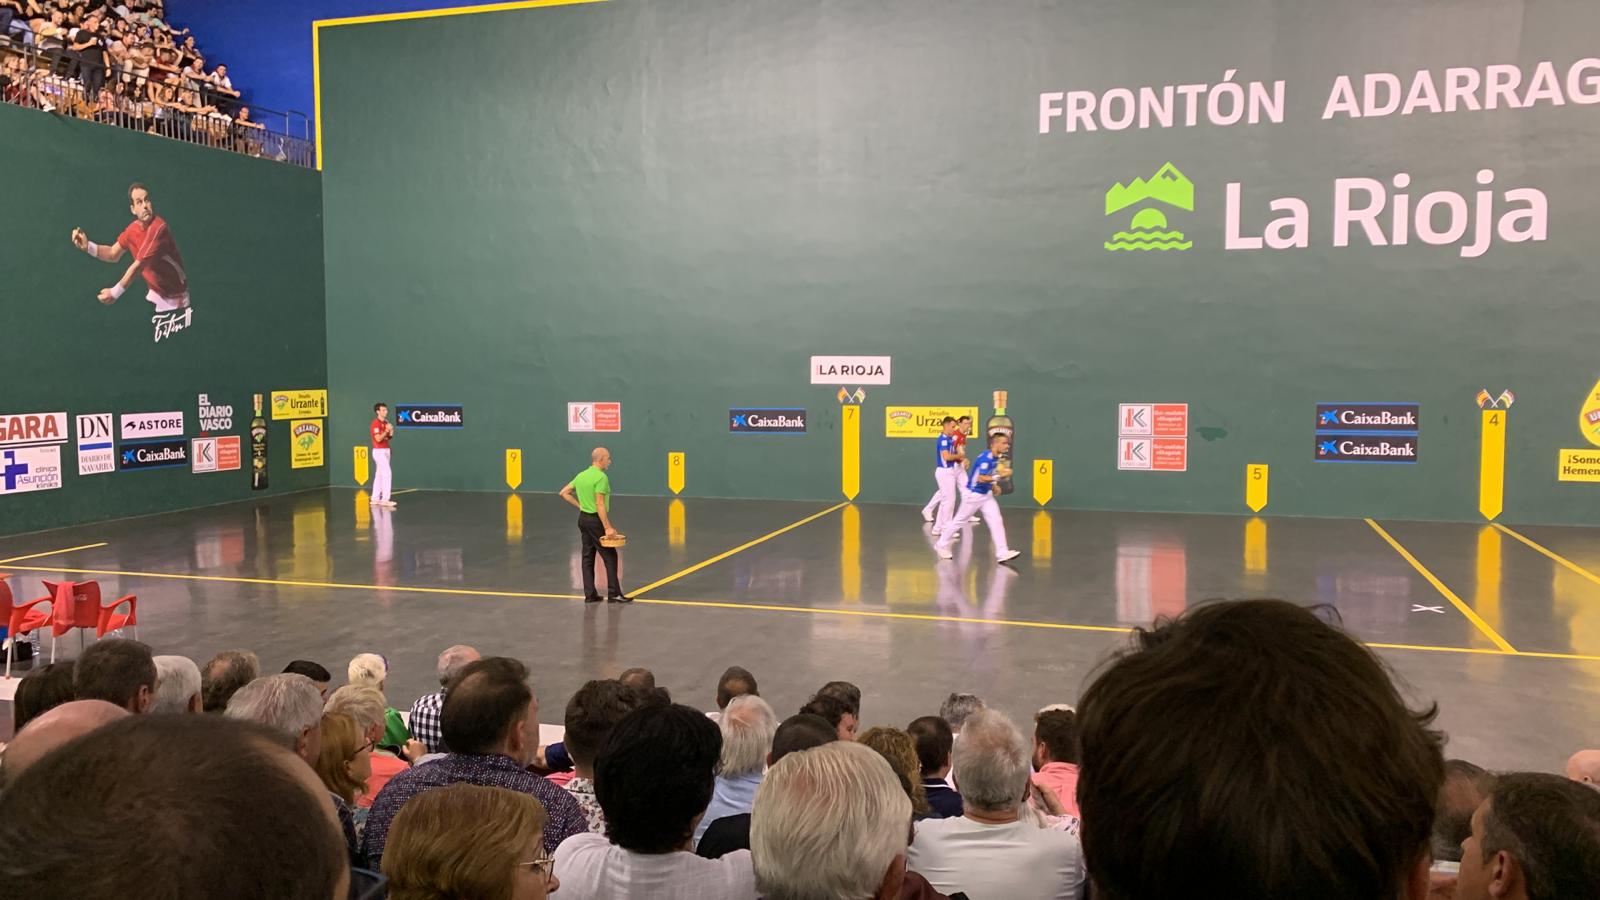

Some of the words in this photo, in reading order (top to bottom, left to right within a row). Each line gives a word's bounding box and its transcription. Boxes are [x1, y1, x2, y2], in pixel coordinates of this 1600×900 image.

[1038, 69, 1286, 134] FRONTÓN
[1321, 58, 1600, 120] ADARRAG
[1224, 182, 1310, 251] La
[1333, 169, 1550, 258] Rioja
[819, 364, 838, 376] LA
[840, 364, 885, 376] RIOJA
[198, 393, 211, 406] EL
[290, 398, 319, 410] Urzante
[198, 405, 233, 418] DIARIO
[411, 410, 461, 423] CaixaBank
[847, 408, 855, 420] 7
[1340, 410, 1416, 425] CaixaBank
[138, 418, 182, 431] ASTORE
[199, 418, 233, 431] VASCO
[747, 414, 805, 428] CaixaBank
[1489, 413, 1499, 427] 4
[79, 415, 110, 439] DN
[136, 446, 186, 463] CaixaBank
[355, 449, 367, 460] 10
[1339, 440, 1415, 456] CaixaBank
[81, 454, 103, 463] DIARIO
[103, 453, 112, 461] DE
[510, 452, 517, 463] 9
[673, 455, 680, 466] 8
[81, 463, 114, 473] NAVARRA
[1039, 463, 1048, 475] 6
[1253, 467, 1262, 480] 5
